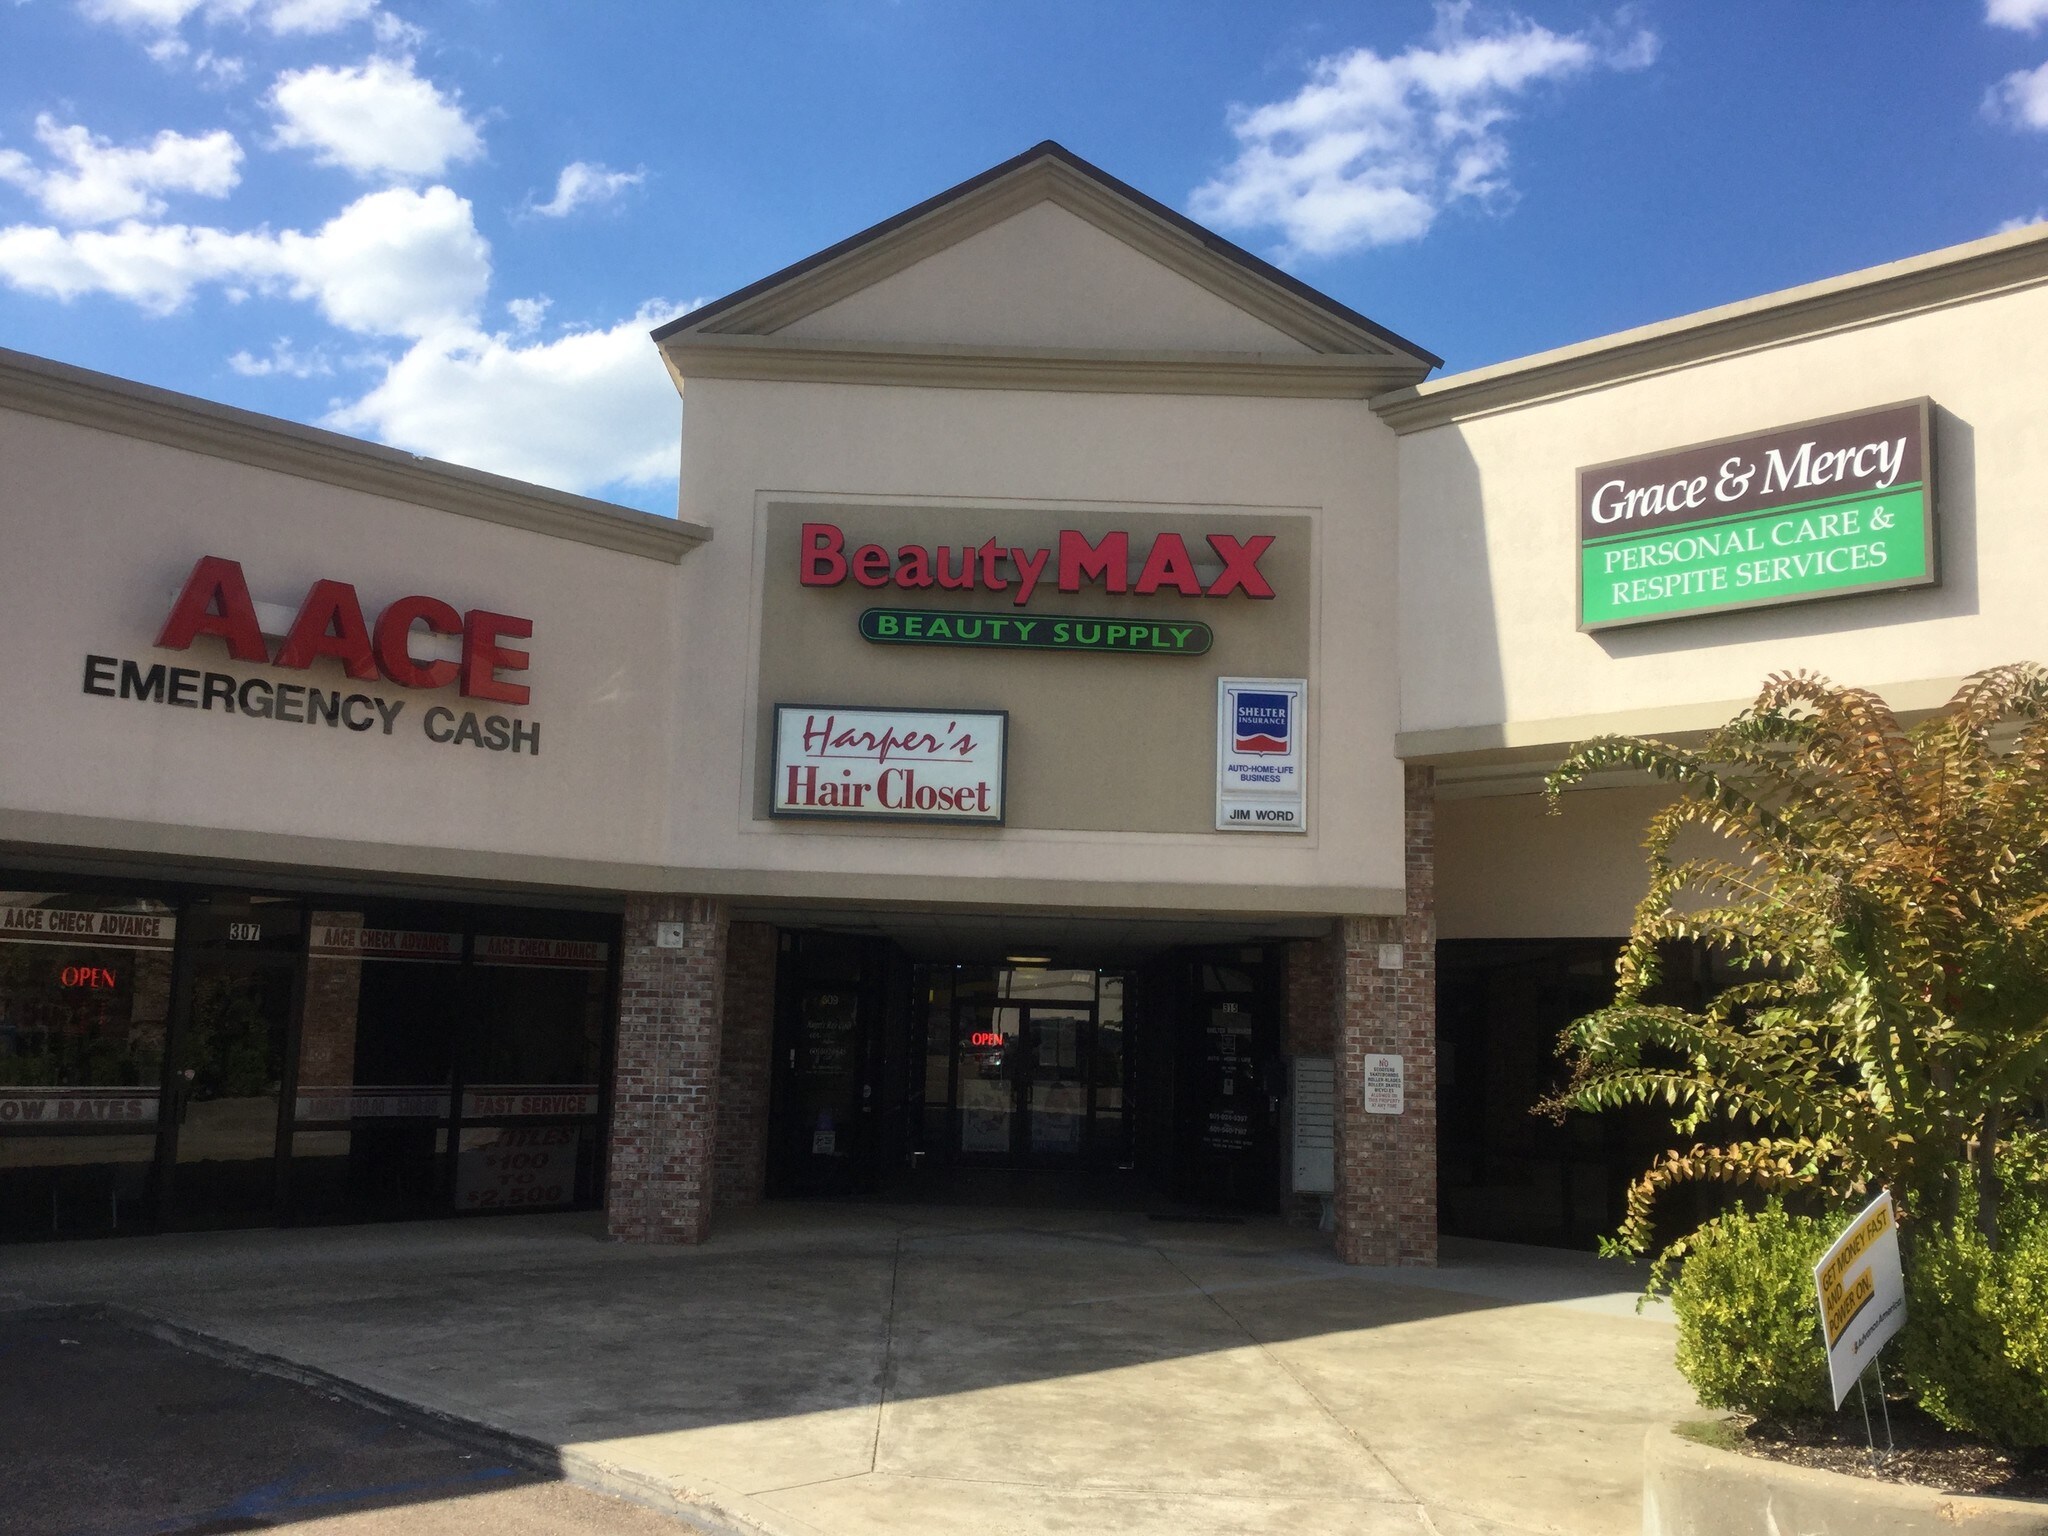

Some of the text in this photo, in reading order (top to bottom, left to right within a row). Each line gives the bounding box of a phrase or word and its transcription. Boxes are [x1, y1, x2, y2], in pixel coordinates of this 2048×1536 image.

[1591, 437, 1907, 524] Grace & Mercy
[1603, 505, 1895, 574] PERSONAL CARE &
[1611, 541, 1888, 606] RESPITE SERVICES
[153, 555, 533, 706] AACE
[878, 615, 1194, 649] BEAUTY SUPPLY
[83, 654, 541, 755] EMERGENCY CASH
[1238, 706, 1286, 718] SHELTER
[1238, 716, 1286, 725] INSURANCE
[802, 715, 978, 763] Harper's
[785, 764, 991, 812] Hair Closet
[1240, 774, 1281, 783] BUSINESS
[1229, 809, 1294, 821] JIM WORD
[4, 908, 160, 937] AACE CHECK ADVANCE
[230, 924, 260, 940] 307
[324, 928, 451, 952] AACE CHECK ADVANCE
[518, 940, 551, 957] CHECK
[555, 942, 598, 959] ADVANCE
[60, 966, 116, 989] OPEN
[972, 1032, 1003, 1046] OPEN
[58, 1101, 142, 1120] RATES
[474, 1095, 587, 1115] FAST SERVICE
[1822, 1209, 1887, 1292] GET MONEY FAST
[1827, 1282, 1843, 1313] AND
[1829, 1274, 1872, 1337] POWER ON.
